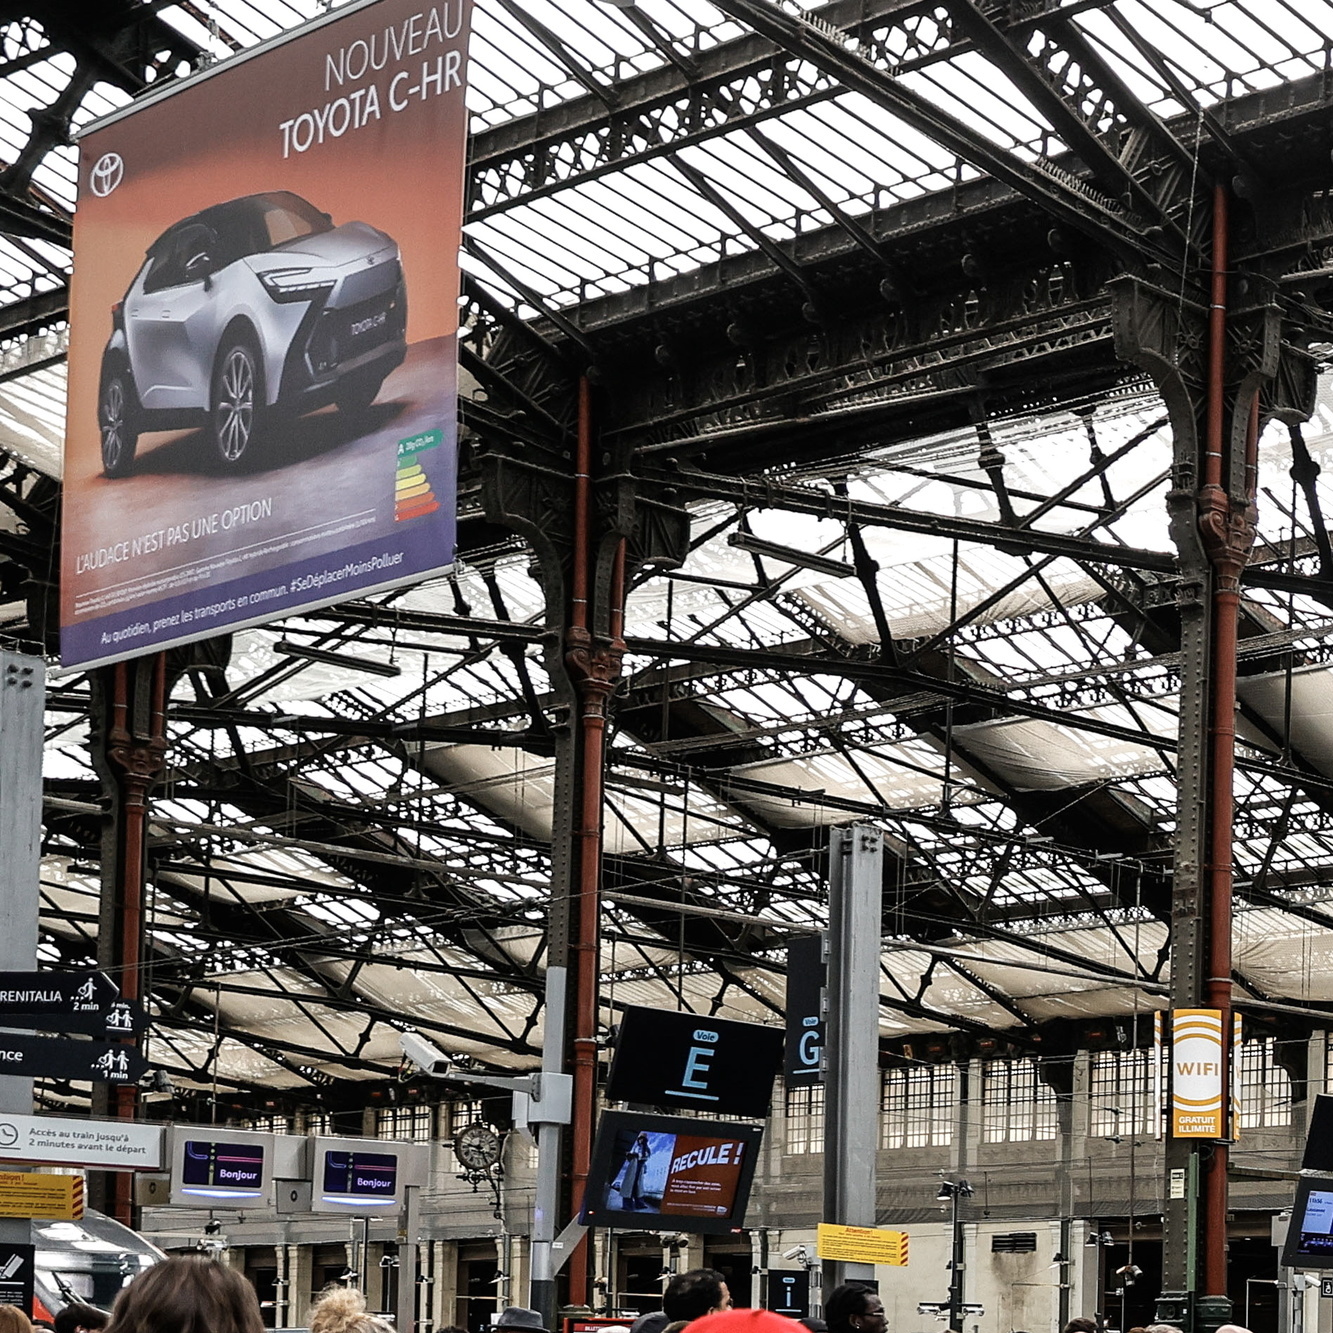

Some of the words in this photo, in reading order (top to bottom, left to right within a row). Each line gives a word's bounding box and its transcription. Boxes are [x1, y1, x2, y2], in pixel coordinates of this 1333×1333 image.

[325, 0, 462, 91] NOUVEAU
[279, 84, 381, 158] TOYOTA
[389, 50, 461, 112] C-HR
[76, 541, 129, 574] L'AUDACE
[132, 531, 165, 558] N'EST
[167, 523, 190, 546] PAS
[192, 514, 218, 539] UNE
[221, 498, 272, 530] OPTION
[290, 552, 404, 593] #SeDéplacerMoinsPolluer
[101, 631, 111, 644] Au
[113, 622, 151, 642] quotidien,
[153, 614, 179, 635] prenez
[181, 611, 193, 623] les
[195, 597, 236, 620] transports
[237, 596, 248, 607] en
[250, 585, 288, 604] commun.
[73, 1002, 79, 1010] 2
[81, 1002, 99, 1011] min
[697, 1032, 715, 1041] Voie
[800, 1030, 819, 1065] G
[110, 1070, 128, 1079] min
[682, 1047, 715, 1089] E
[1176, 1062, 1218, 1076] WIFI
[1179, 1116, 1215, 1124] GRATUIT
[29, 1128, 56, 1137] Accès
[73, 1131, 94, 1139] train
[96, 1132, 129, 1142] jusqu'à
[37, 1140, 75, 1149] minutes
[78, 1143, 102, 1151] avant
[116, 1144, 146, 1155] départ
[671, 1143, 733, 1174] RECULE
[220, 1169, 257, 1181] Bonjour
[357, 1177, 392, 1188] Bonjour
